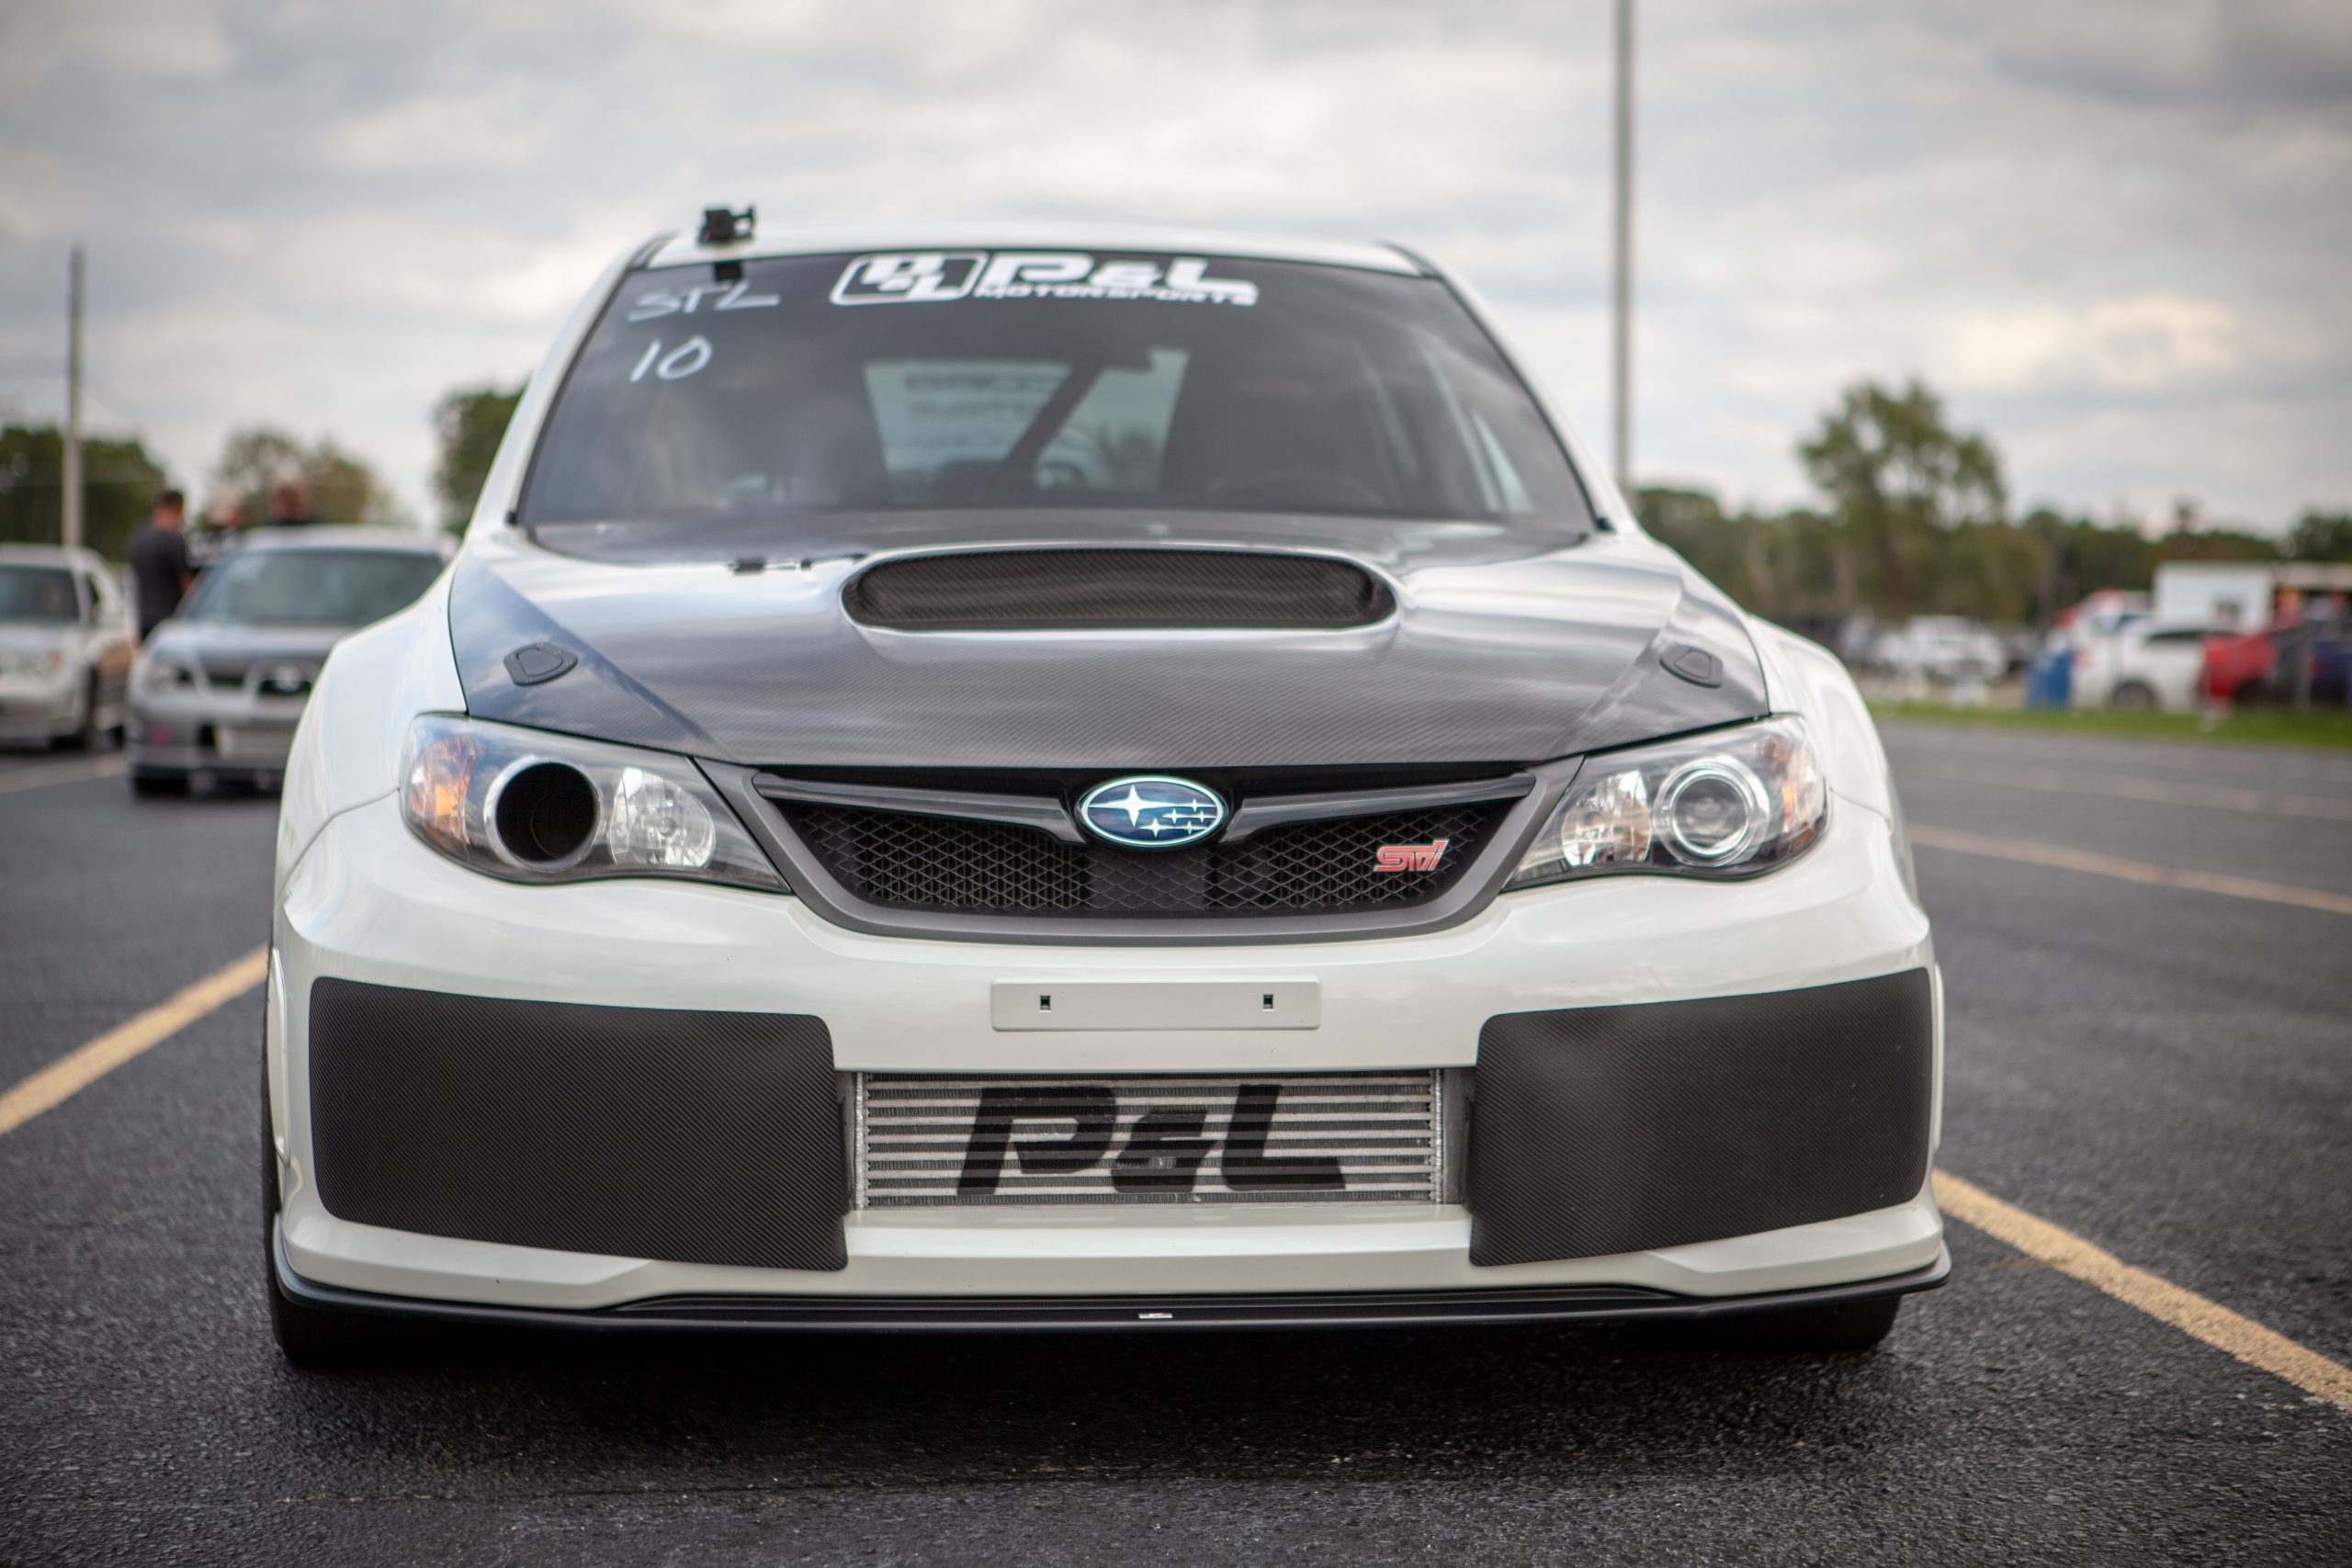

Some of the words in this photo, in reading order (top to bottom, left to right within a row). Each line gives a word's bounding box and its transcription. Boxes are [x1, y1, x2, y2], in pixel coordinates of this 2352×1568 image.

[974, 281, 1258, 306] MOTORSPORTS
[977, 252, 1259, 298] P&L
[629, 334, 714, 382] 10
[956, 1084, 1346, 1195] P&L
